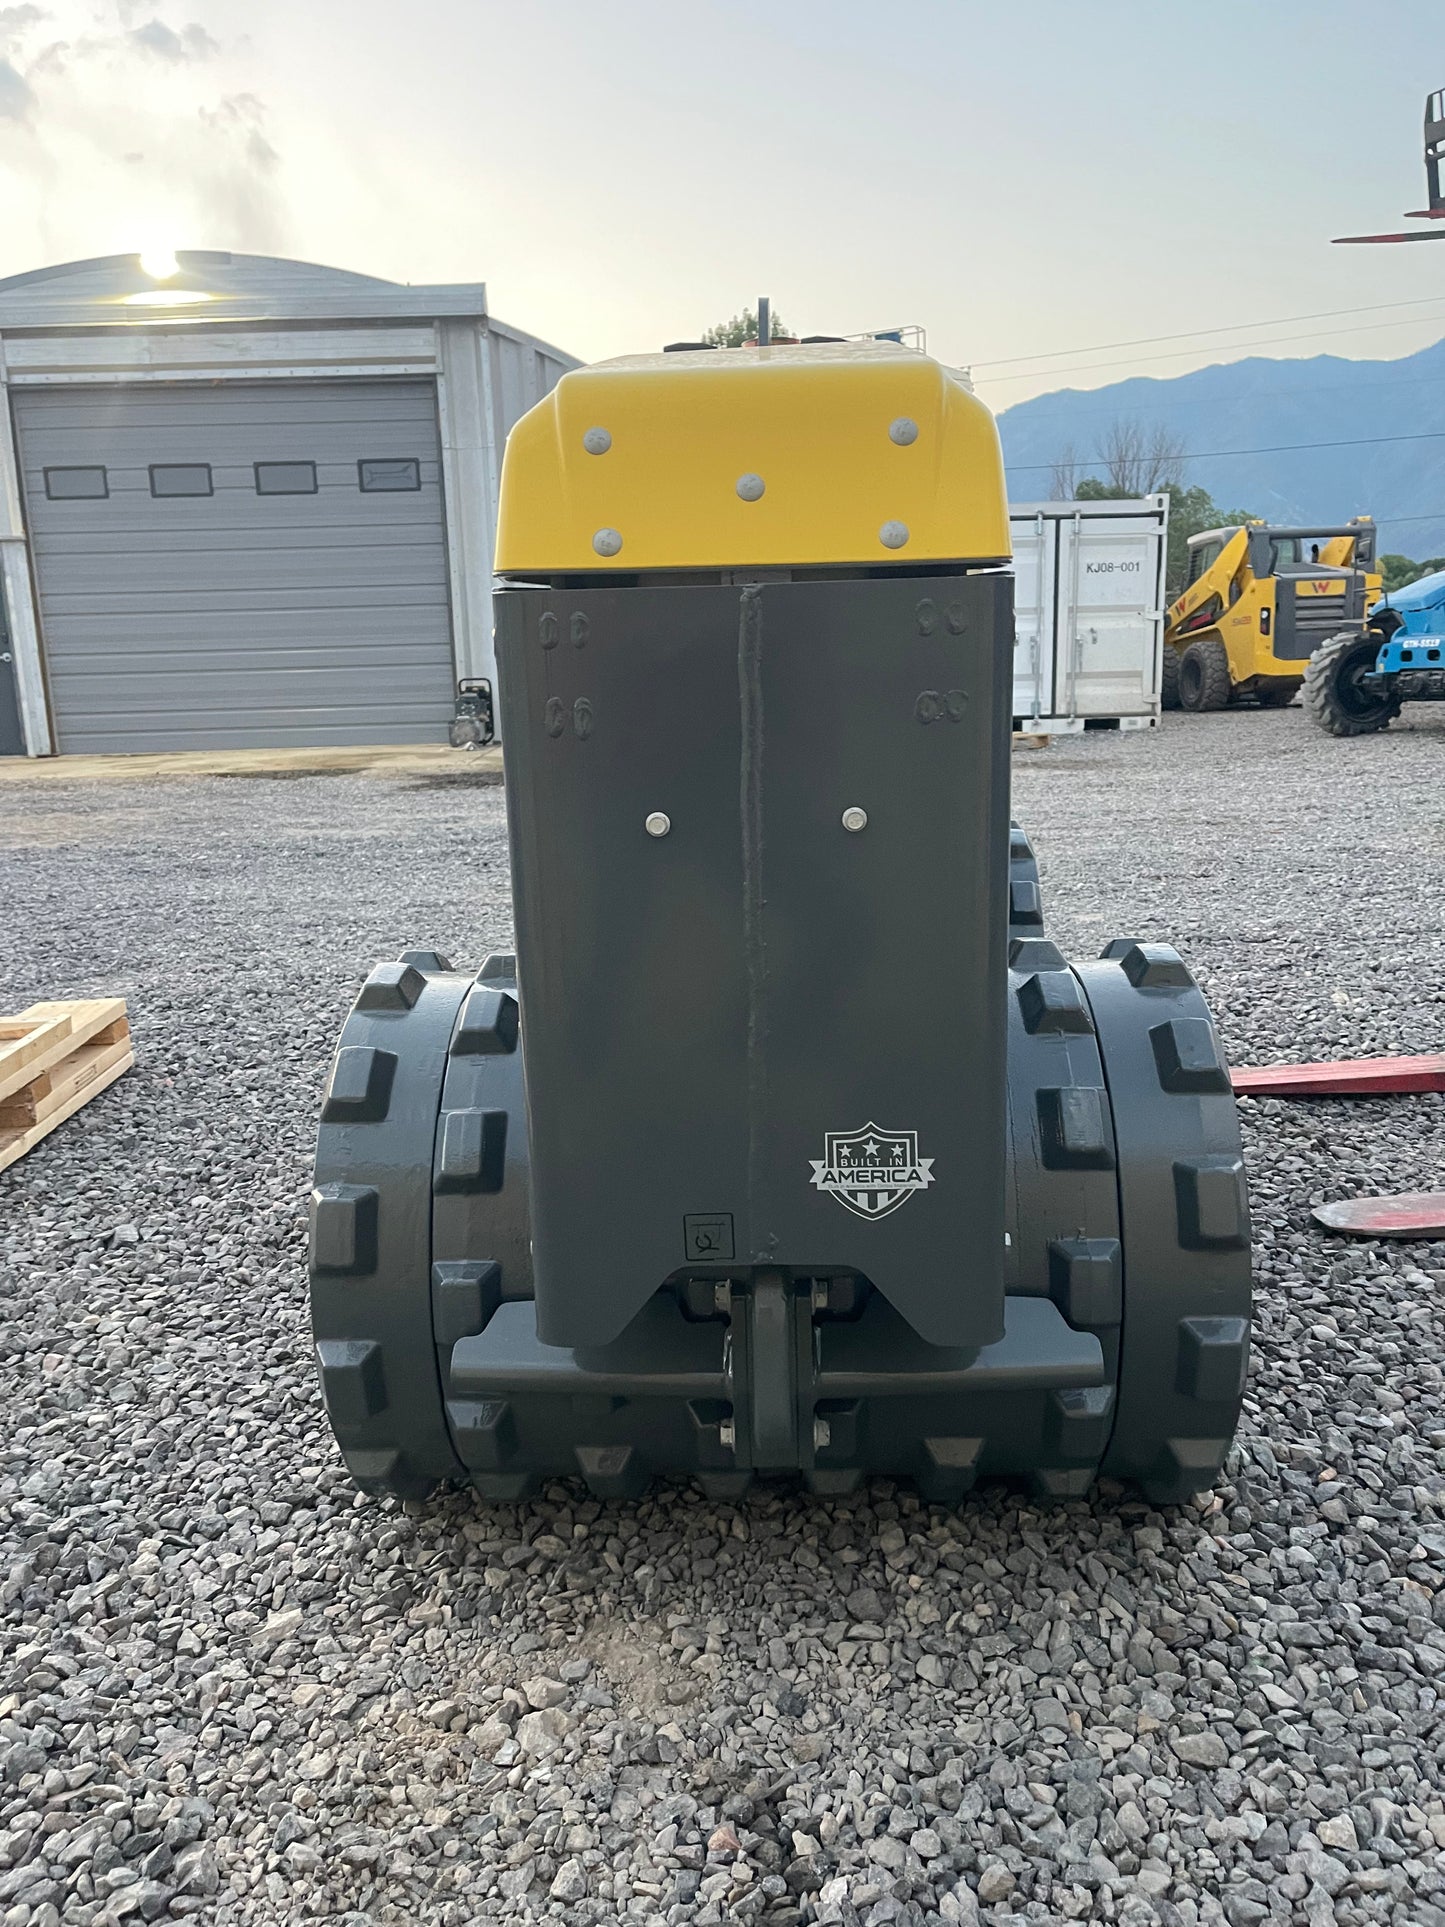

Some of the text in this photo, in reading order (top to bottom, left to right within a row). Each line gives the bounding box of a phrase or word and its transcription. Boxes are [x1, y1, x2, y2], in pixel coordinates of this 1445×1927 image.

[1086, 562, 1140, 573] KJ08-001
[840, 1157, 903, 1167] BUILT IN
[821, 1168, 923, 1184] AMERICA
